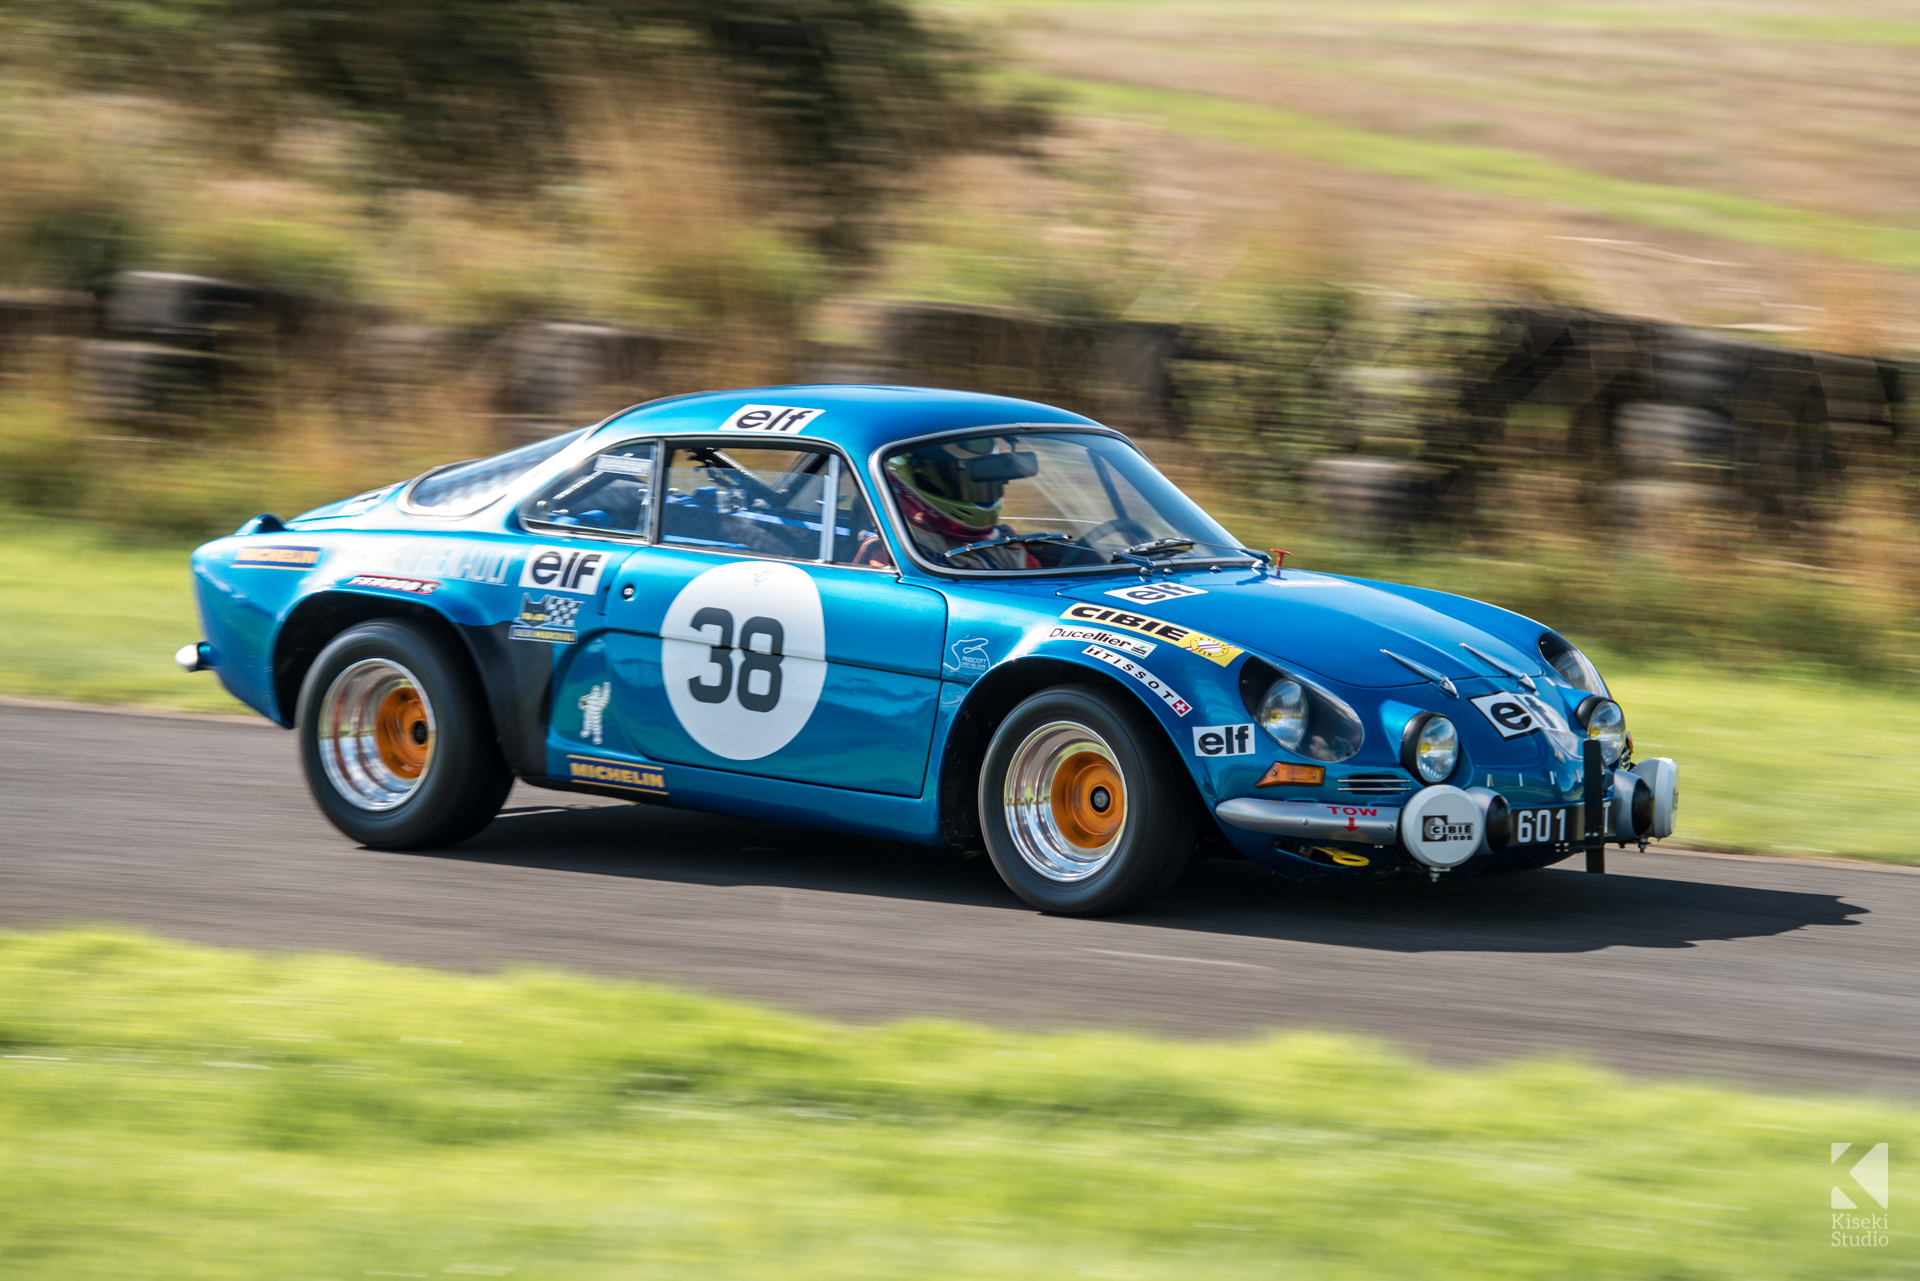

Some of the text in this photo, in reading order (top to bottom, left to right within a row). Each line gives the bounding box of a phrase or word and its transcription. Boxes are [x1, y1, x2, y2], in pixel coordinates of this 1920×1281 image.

[736, 408, 814, 431] elf
[236, 547, 320, 565] MICHELIN
[532, 551, 602, 589] elf
[347, 576, 420, 592] FERODO
[1126, 584, 1195, 600] elf
[1071, 606, 1190, 642] CIBIE
[1049, 628, 1131, 648] Ducellier
[688, 607, 785, 712] 38
[1102, 653, 1174, 699] TISSOT
[1198, 725, 1249, 755] elf
[569, 762, 665, 788] MICHELIN
[1326, 806, 1377, 817] TOW
[1517, 808, 1566, 843] 601
